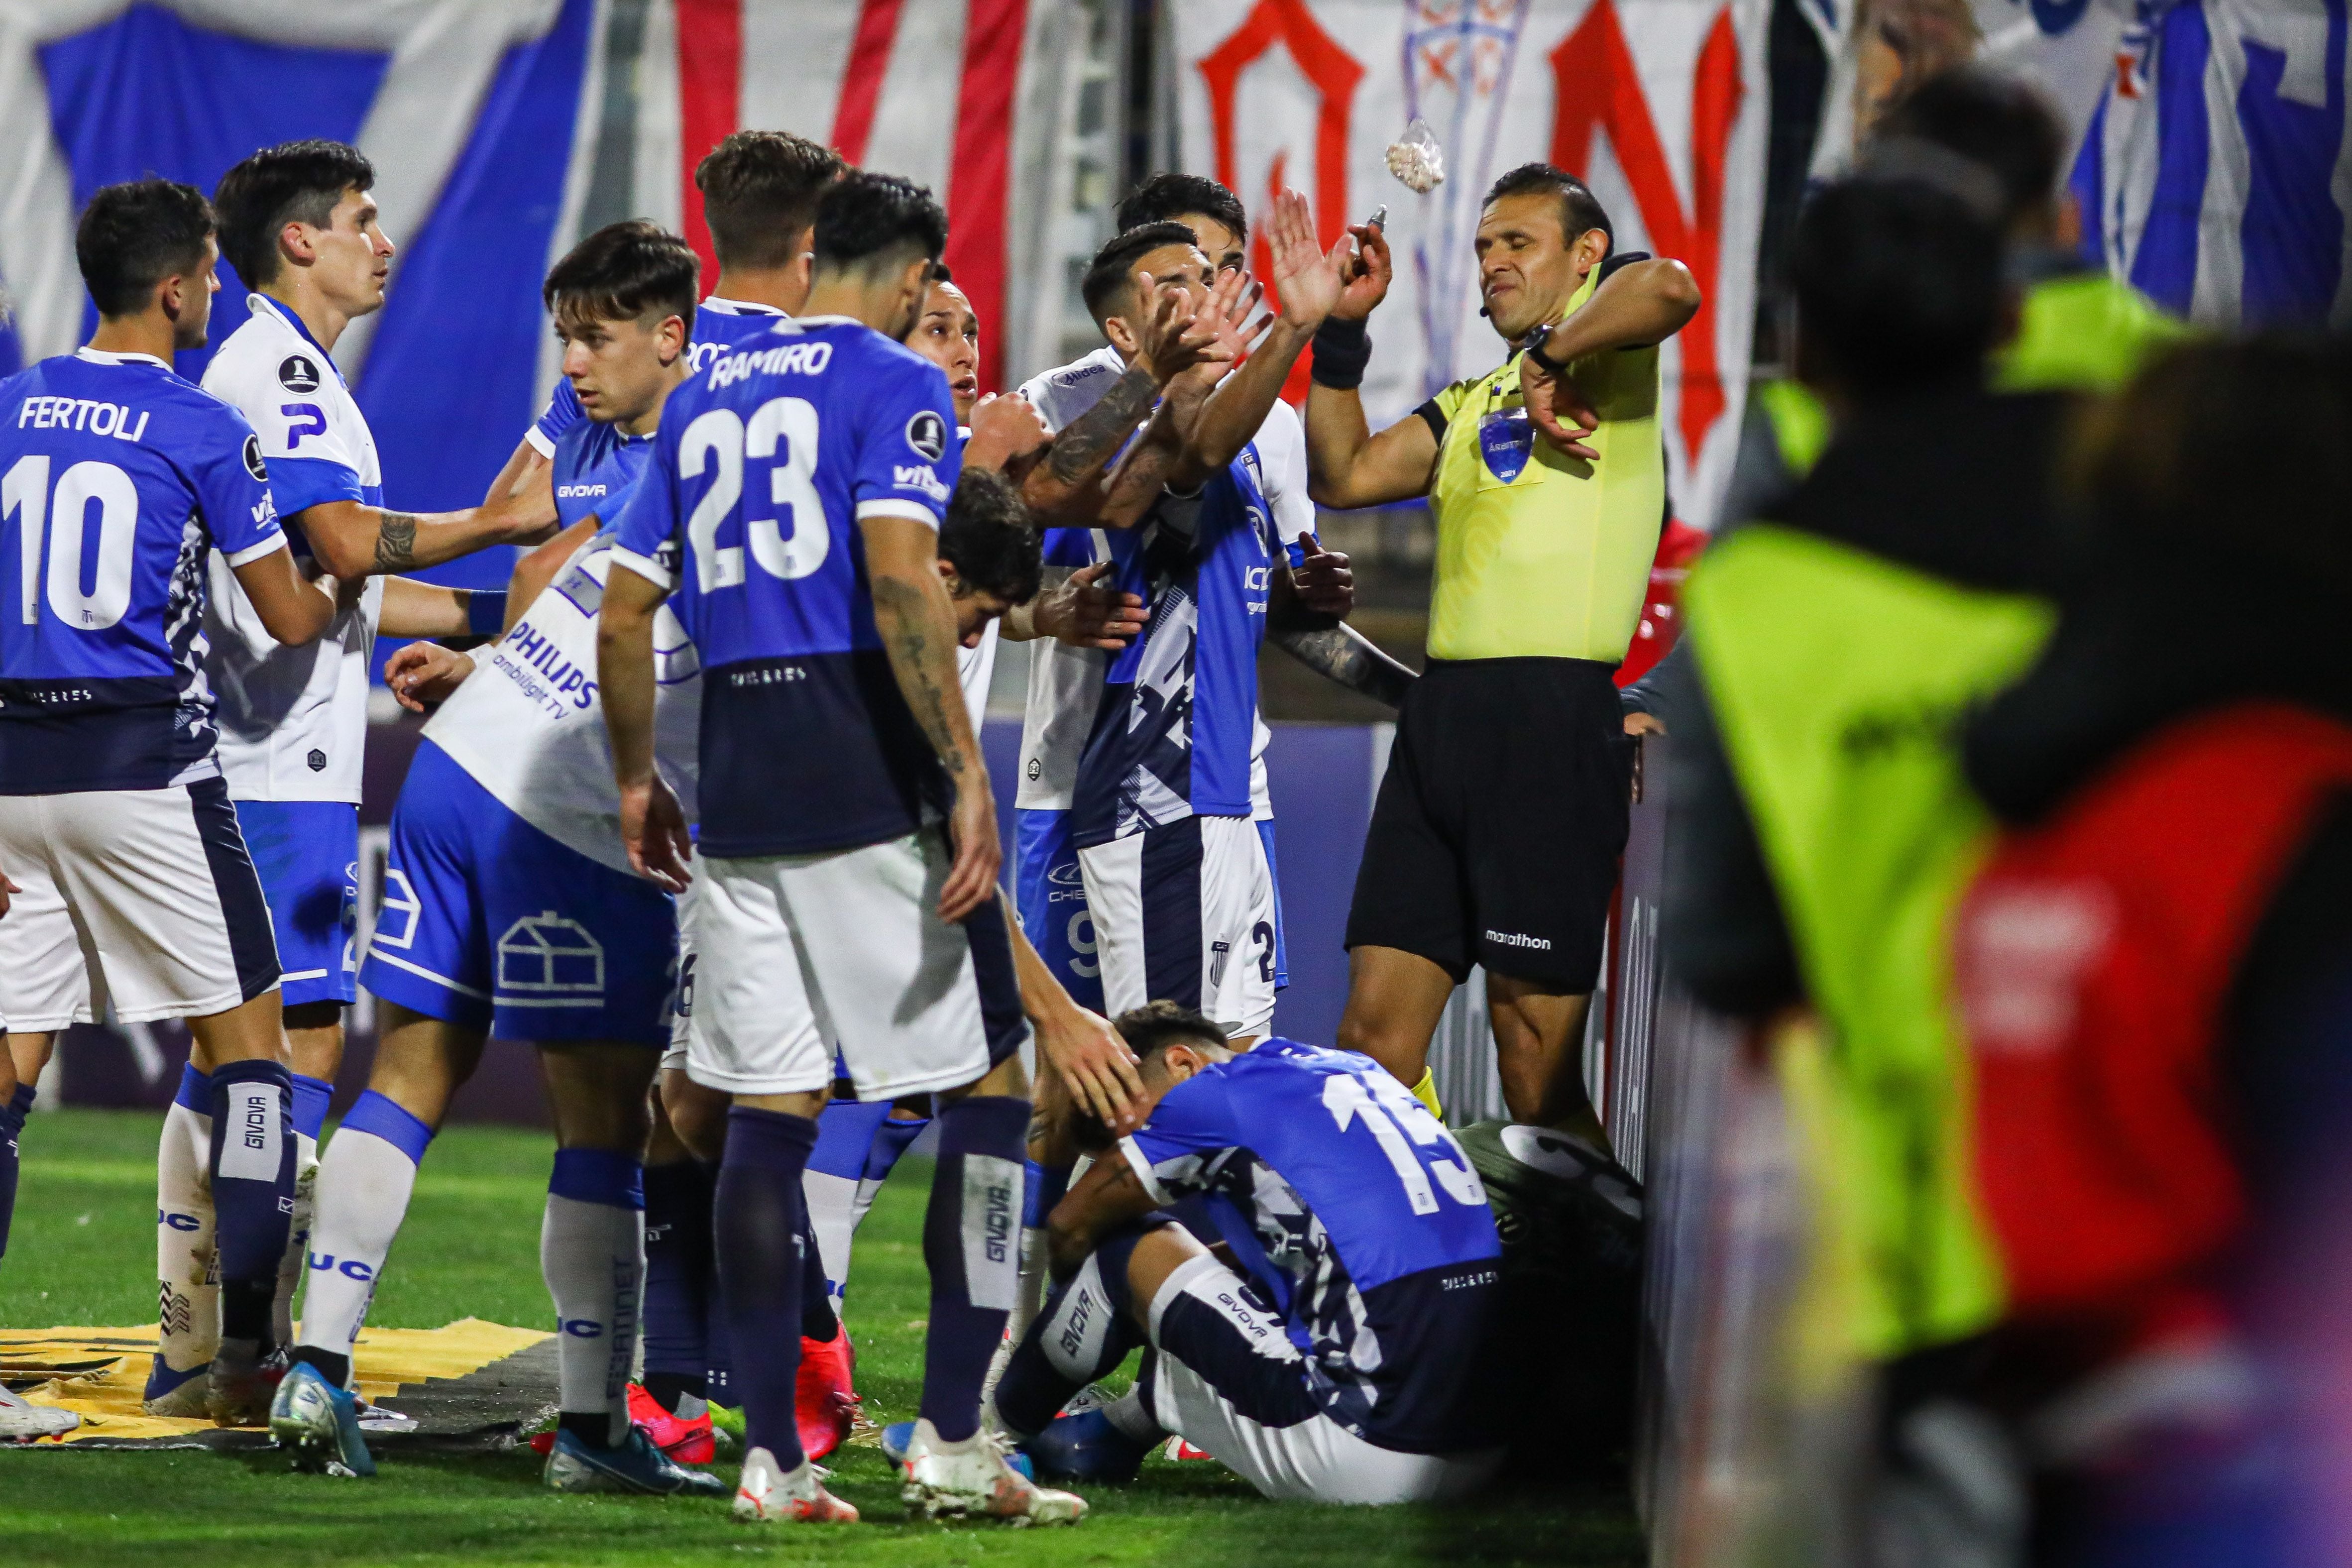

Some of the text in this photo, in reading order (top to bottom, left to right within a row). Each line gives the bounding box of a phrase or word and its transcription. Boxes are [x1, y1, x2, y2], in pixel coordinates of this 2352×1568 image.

[707, 341, 833, 392] RAMIRO
[1064, 364, 1107, 385] Midea
[18, 396, 150, 442] FERTOLI
[678, 397, 830, 594] 23
[1, 454, 138, 630] 10
[505, 622, 599, 709] PHILIPS
[546, 697, 571, 720] TV
[1067, 910, 1101, 978] 9
[1486, 929, 1551, 950] marathon
[243, 1096, 266, 1149] GIVOVA
[1322, 1070, 1488, 1215] 15
[986, 1185, 1011, 1263] GIVOVA
[1060, 1288, 1095, 1357] GIVOVA
[1218, 1292, 1268, 1338] GIVOVA
